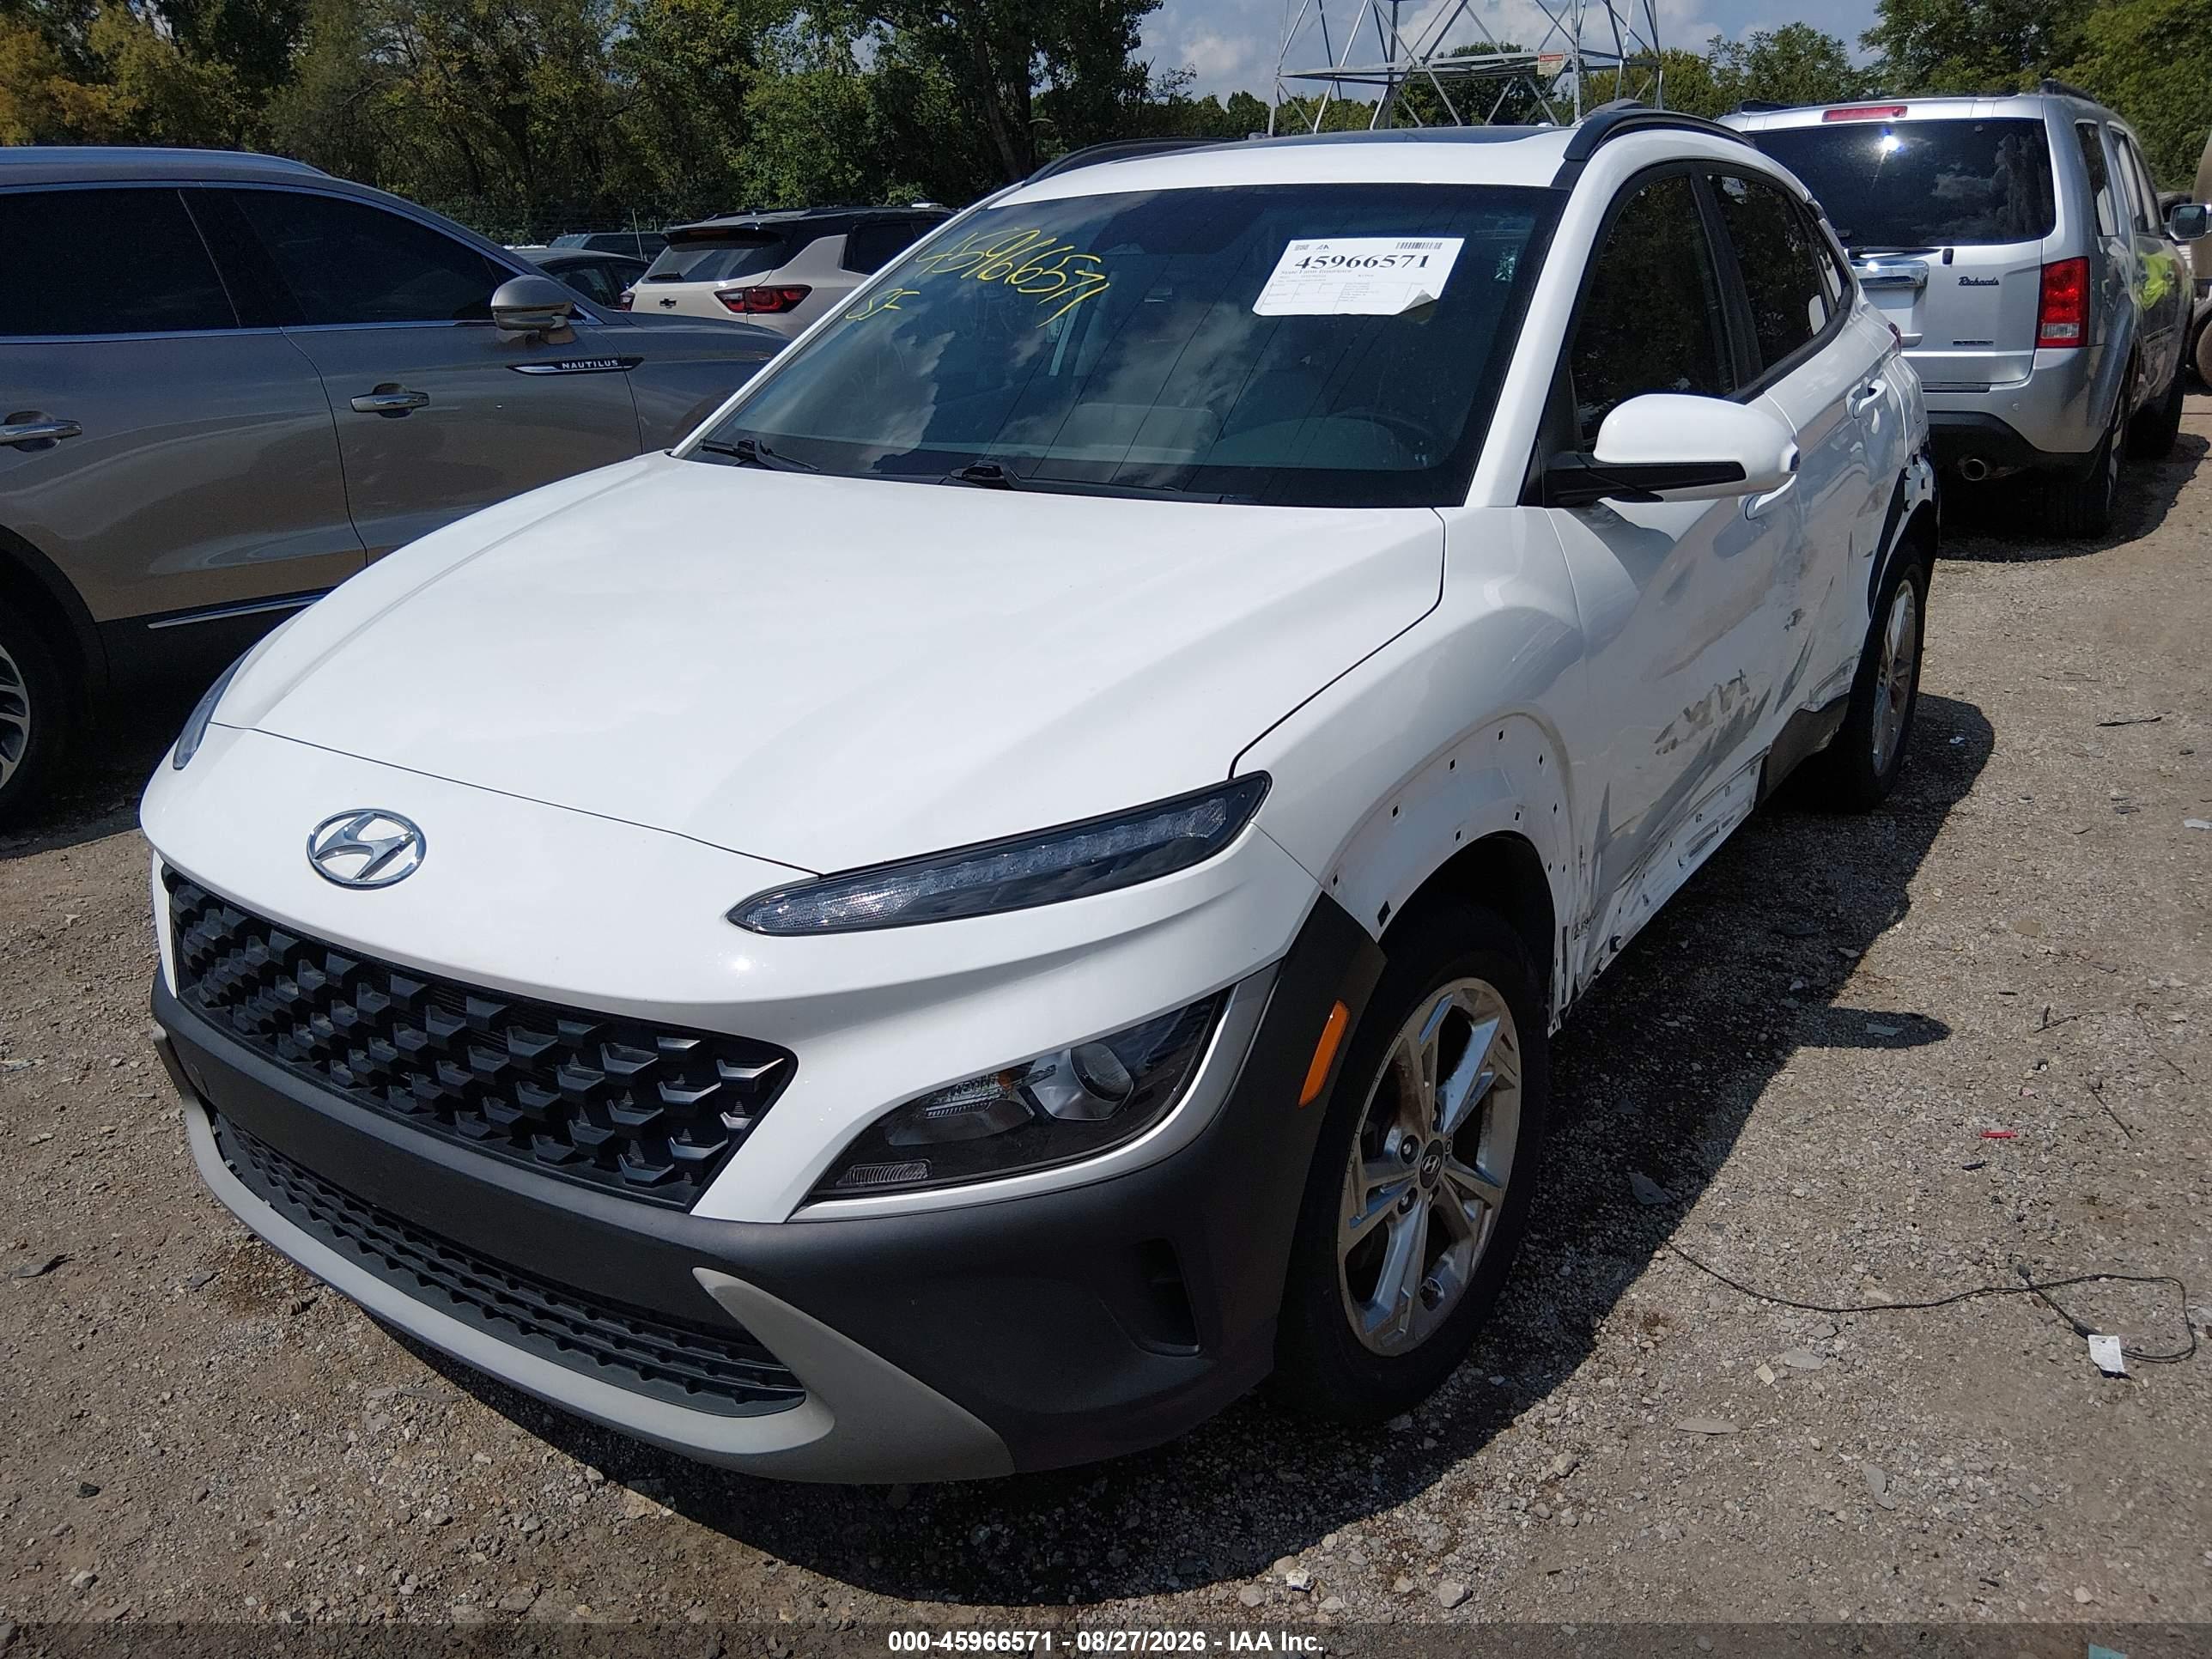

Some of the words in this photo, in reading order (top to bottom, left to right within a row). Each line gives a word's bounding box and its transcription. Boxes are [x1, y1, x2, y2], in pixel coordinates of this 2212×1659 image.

[1295, 254, 1430, 270] 45966571
[1958, 276, 1999, 286] Richards
[562, 360, 618, 369] NAUTILUS
